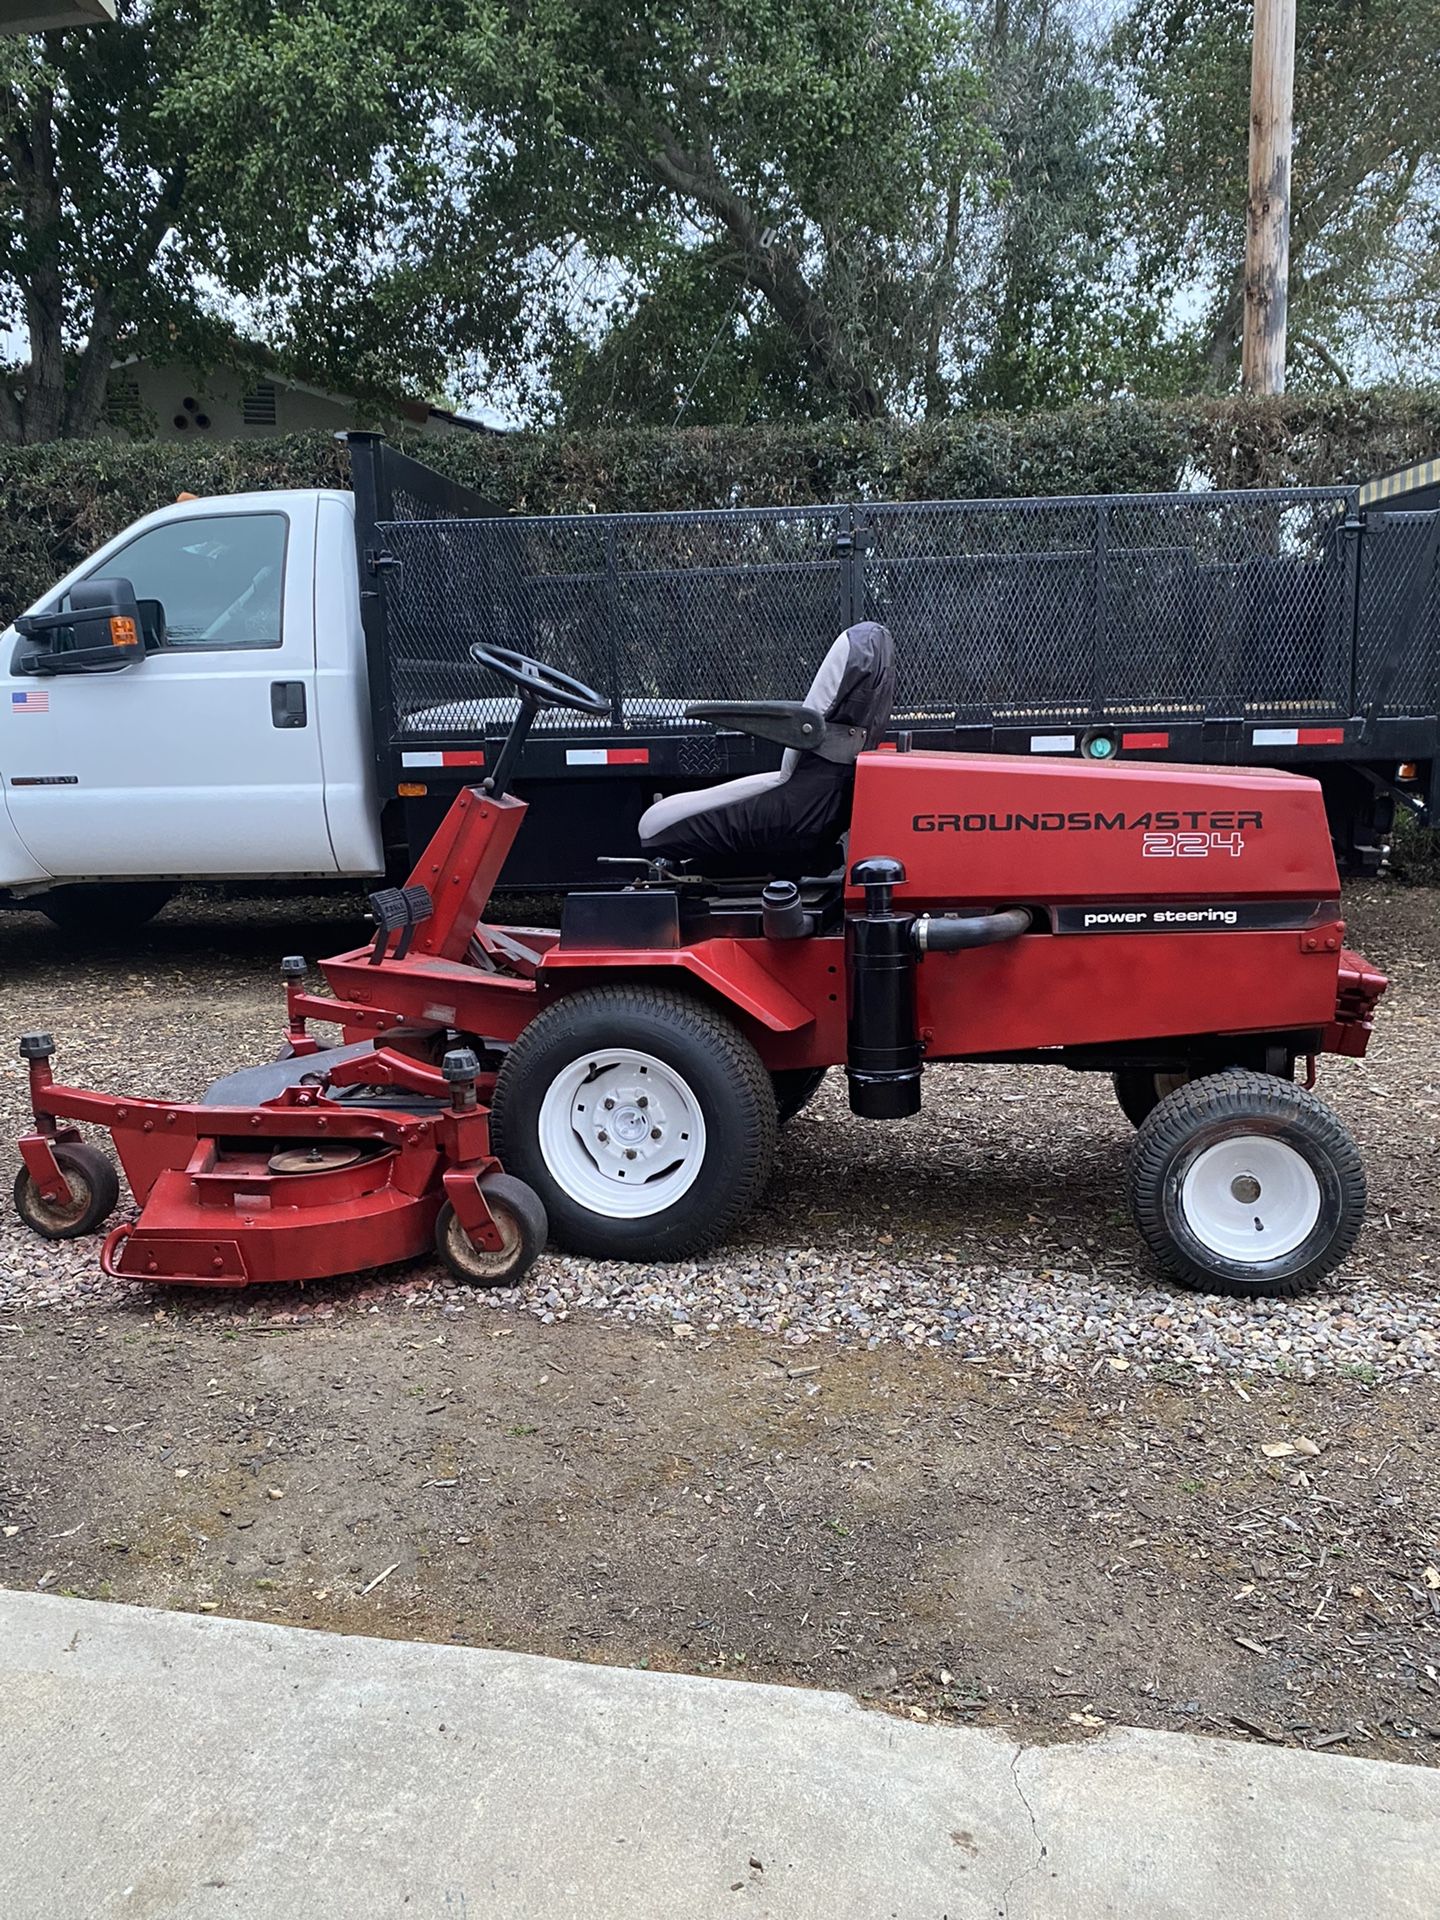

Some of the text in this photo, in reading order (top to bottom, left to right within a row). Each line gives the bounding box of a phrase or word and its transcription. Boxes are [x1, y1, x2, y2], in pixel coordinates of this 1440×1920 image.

[912, 811, 1263, 832] GROUNDSMASTER
[1142, 832, 1245, 857] 224
[1084, 908, 1238, 927] power steering
